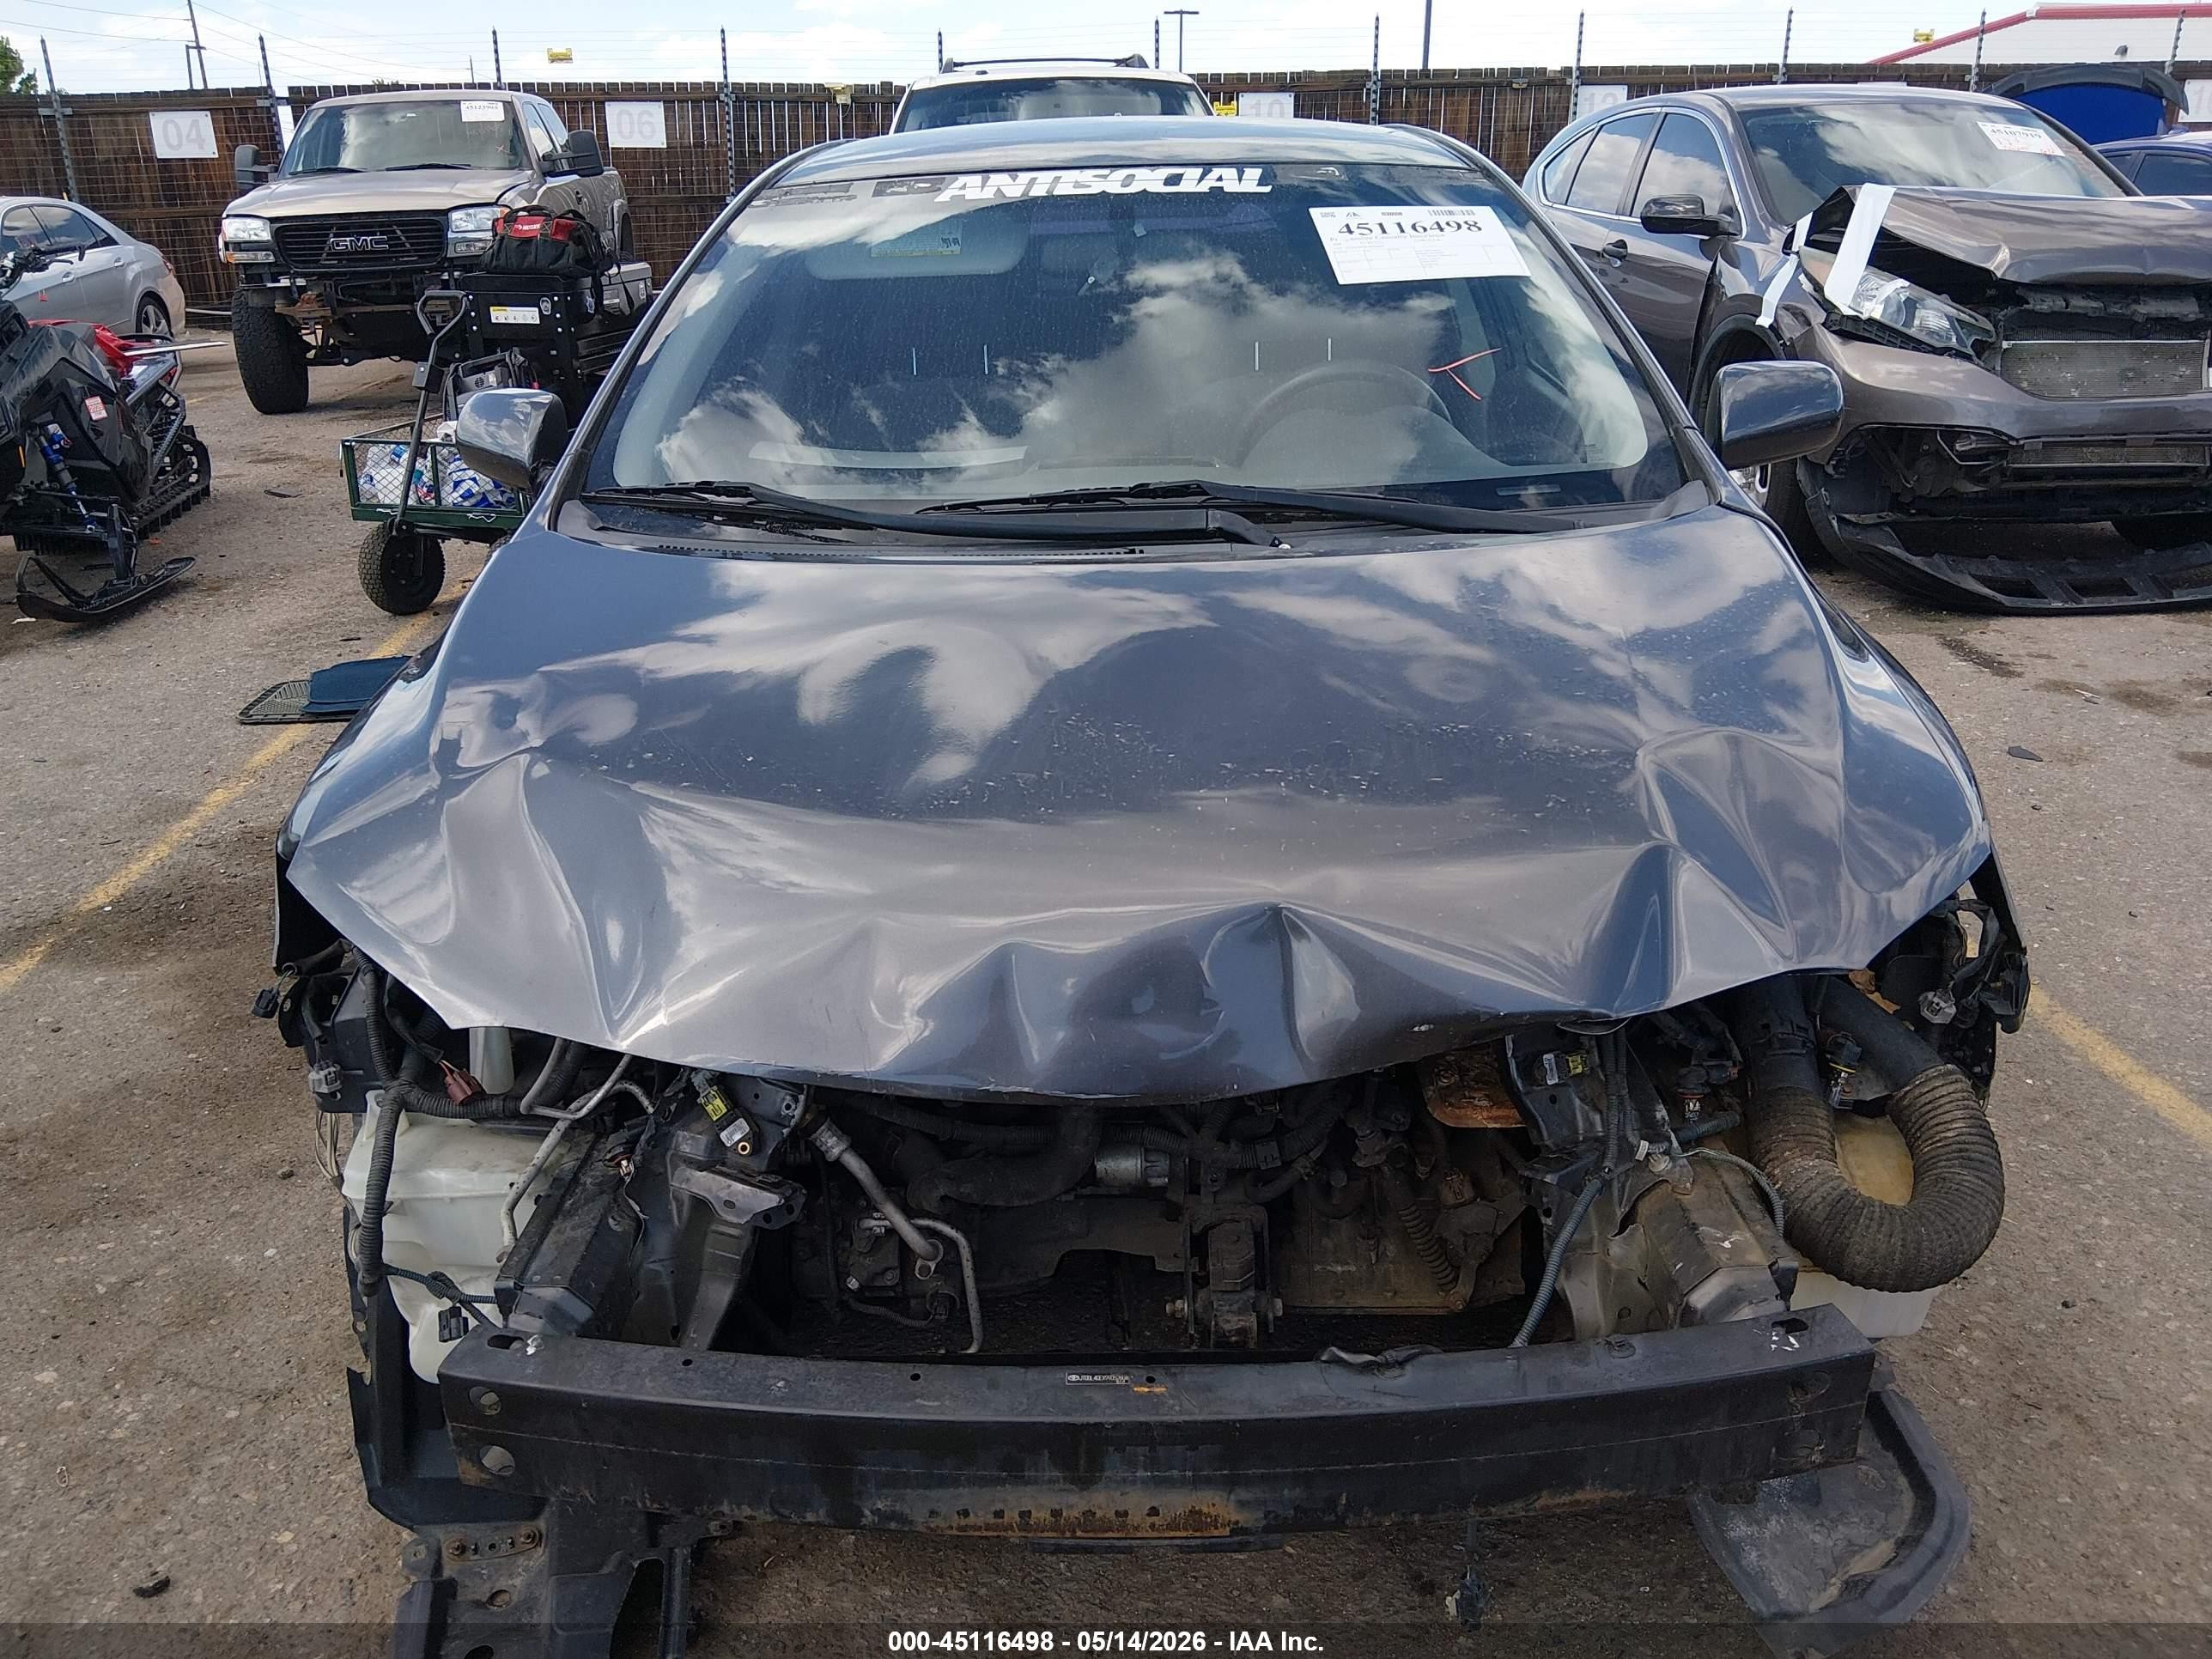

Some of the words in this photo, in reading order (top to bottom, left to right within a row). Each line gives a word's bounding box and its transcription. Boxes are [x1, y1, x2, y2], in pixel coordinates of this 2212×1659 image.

[162, 118, 206, 151] 04
[617, 109, 657, 139] 06
[933, 167, 1273, 202] ANTISOCIAL
[1338, 219, 1482, 236] 45116498
[330, 235, 389, 252] GMC
